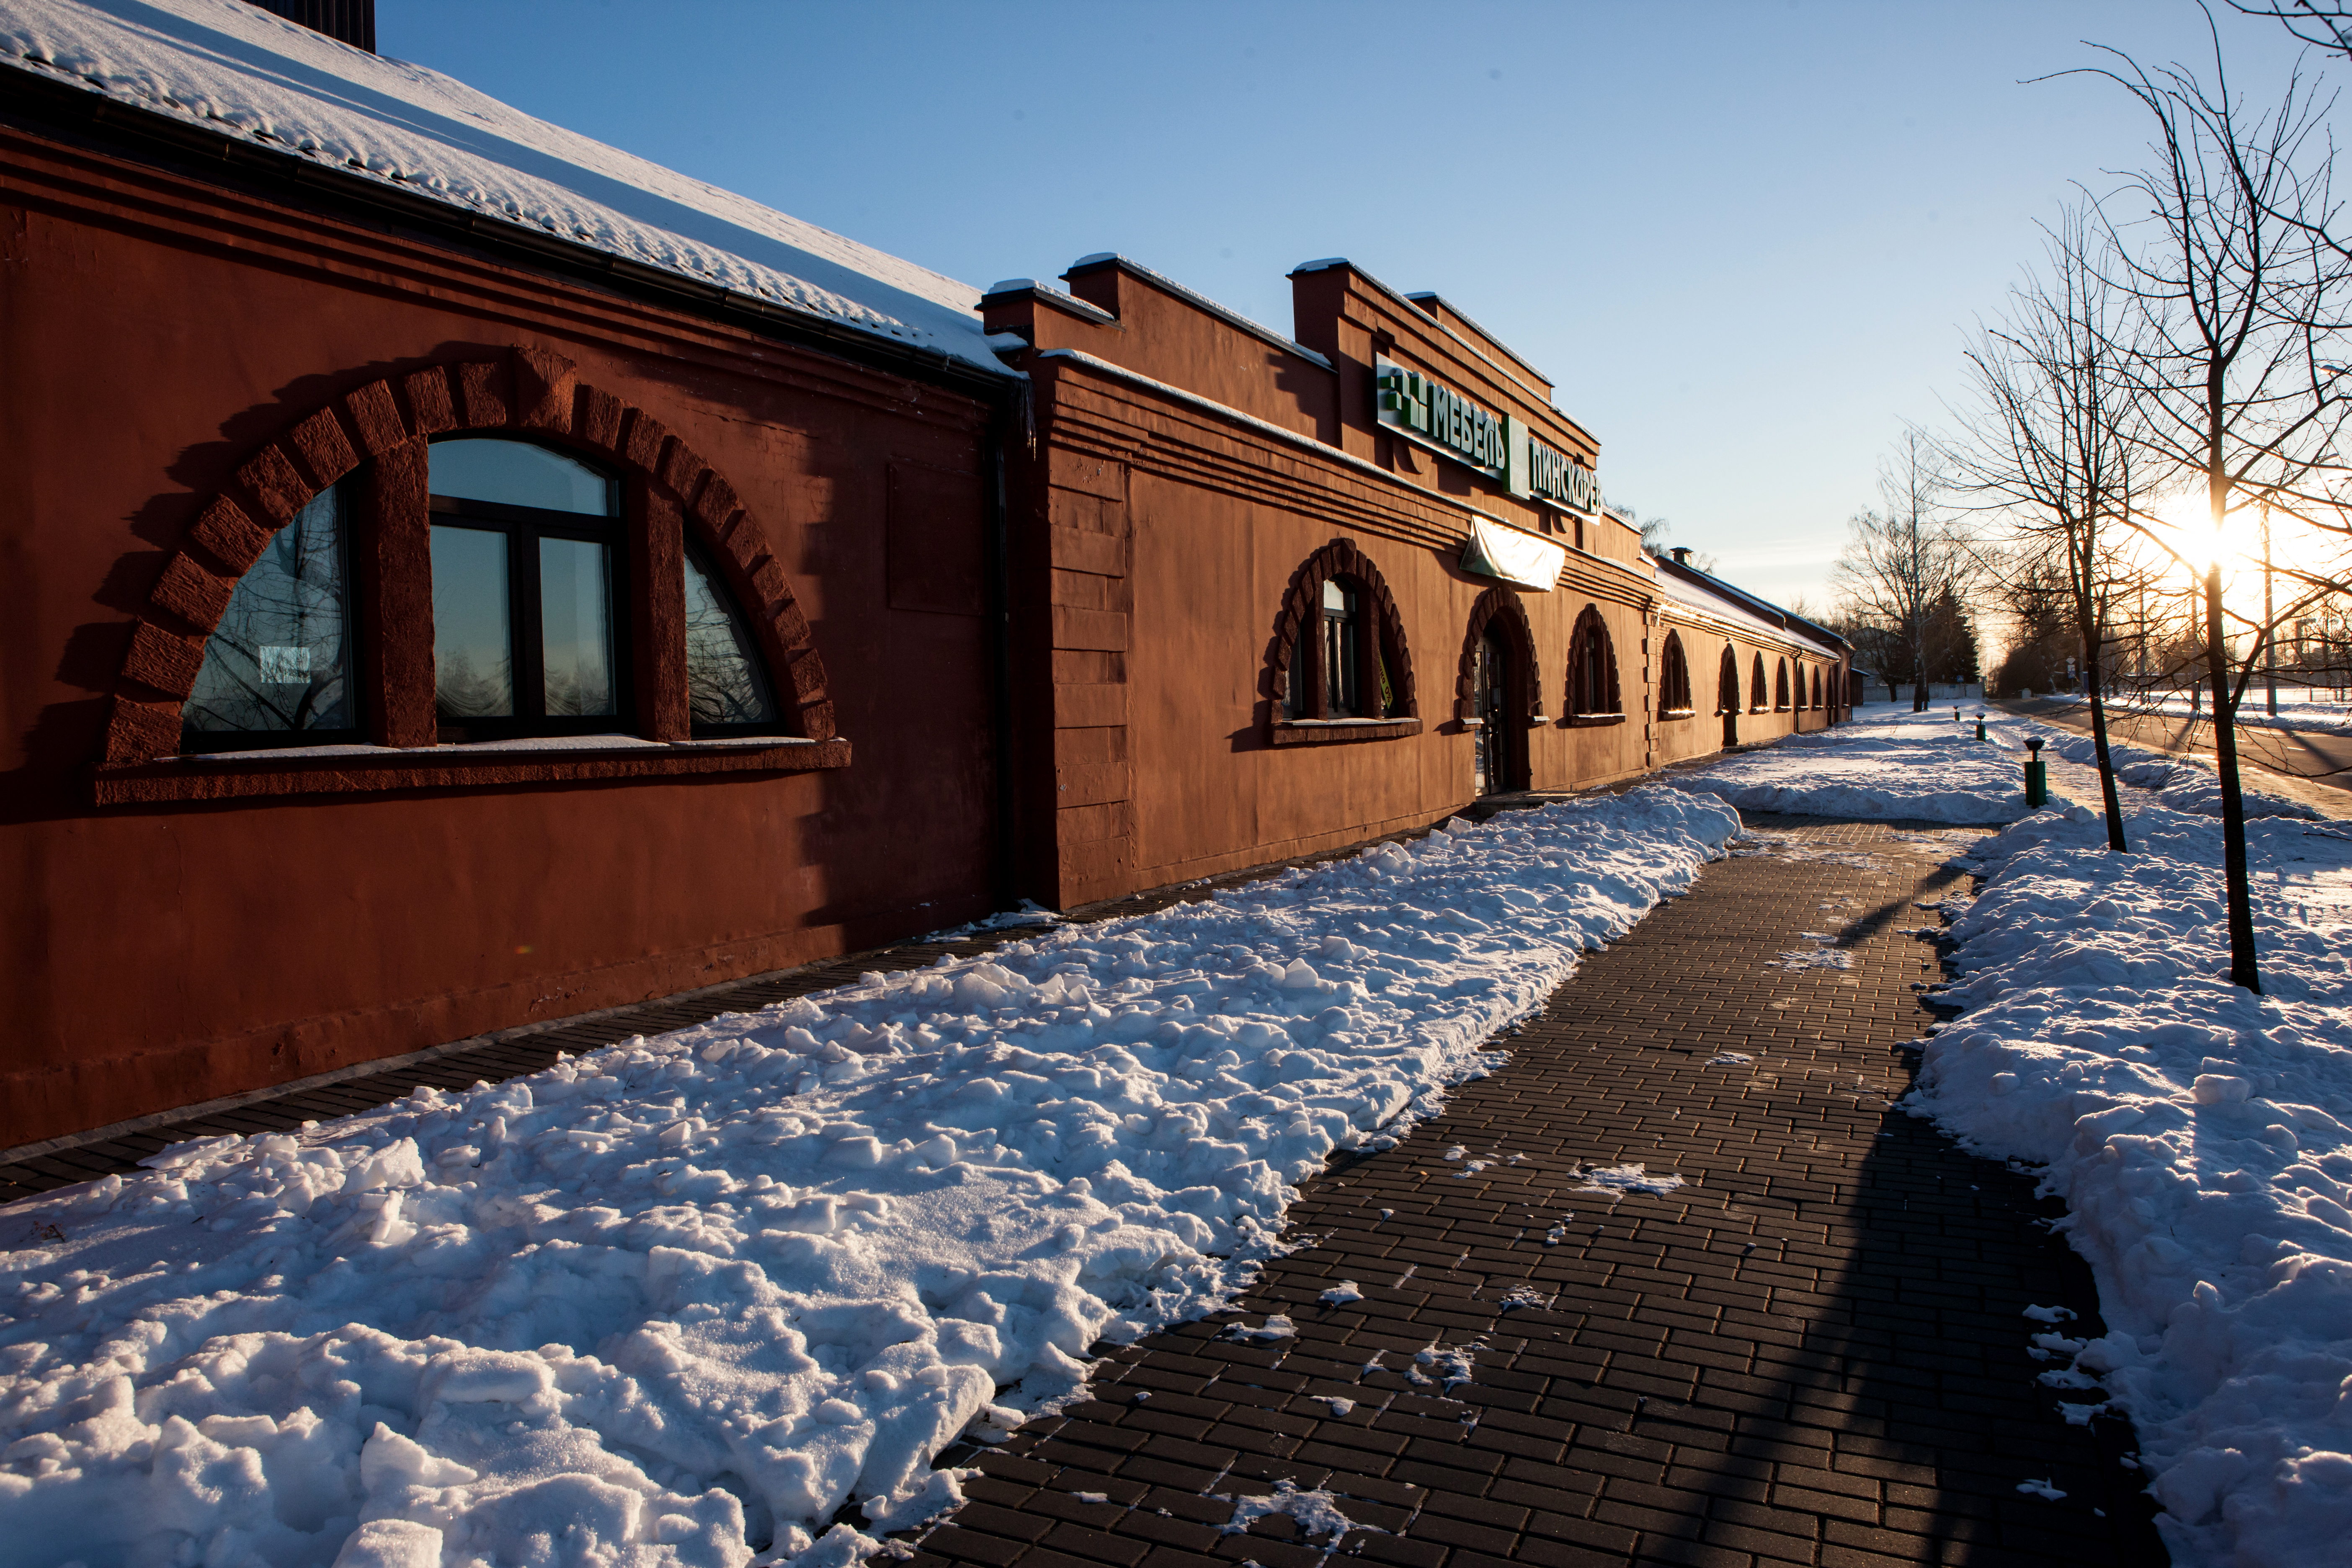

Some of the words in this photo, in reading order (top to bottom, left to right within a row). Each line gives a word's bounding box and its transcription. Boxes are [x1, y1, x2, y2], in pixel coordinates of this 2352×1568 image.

[1433, 385, 1505, 469] МЕБЕЛЬ
[1532, 443, 1603, 517] ПИНСКДРЕВ
[1385, 686, 1392, 703] 0%
